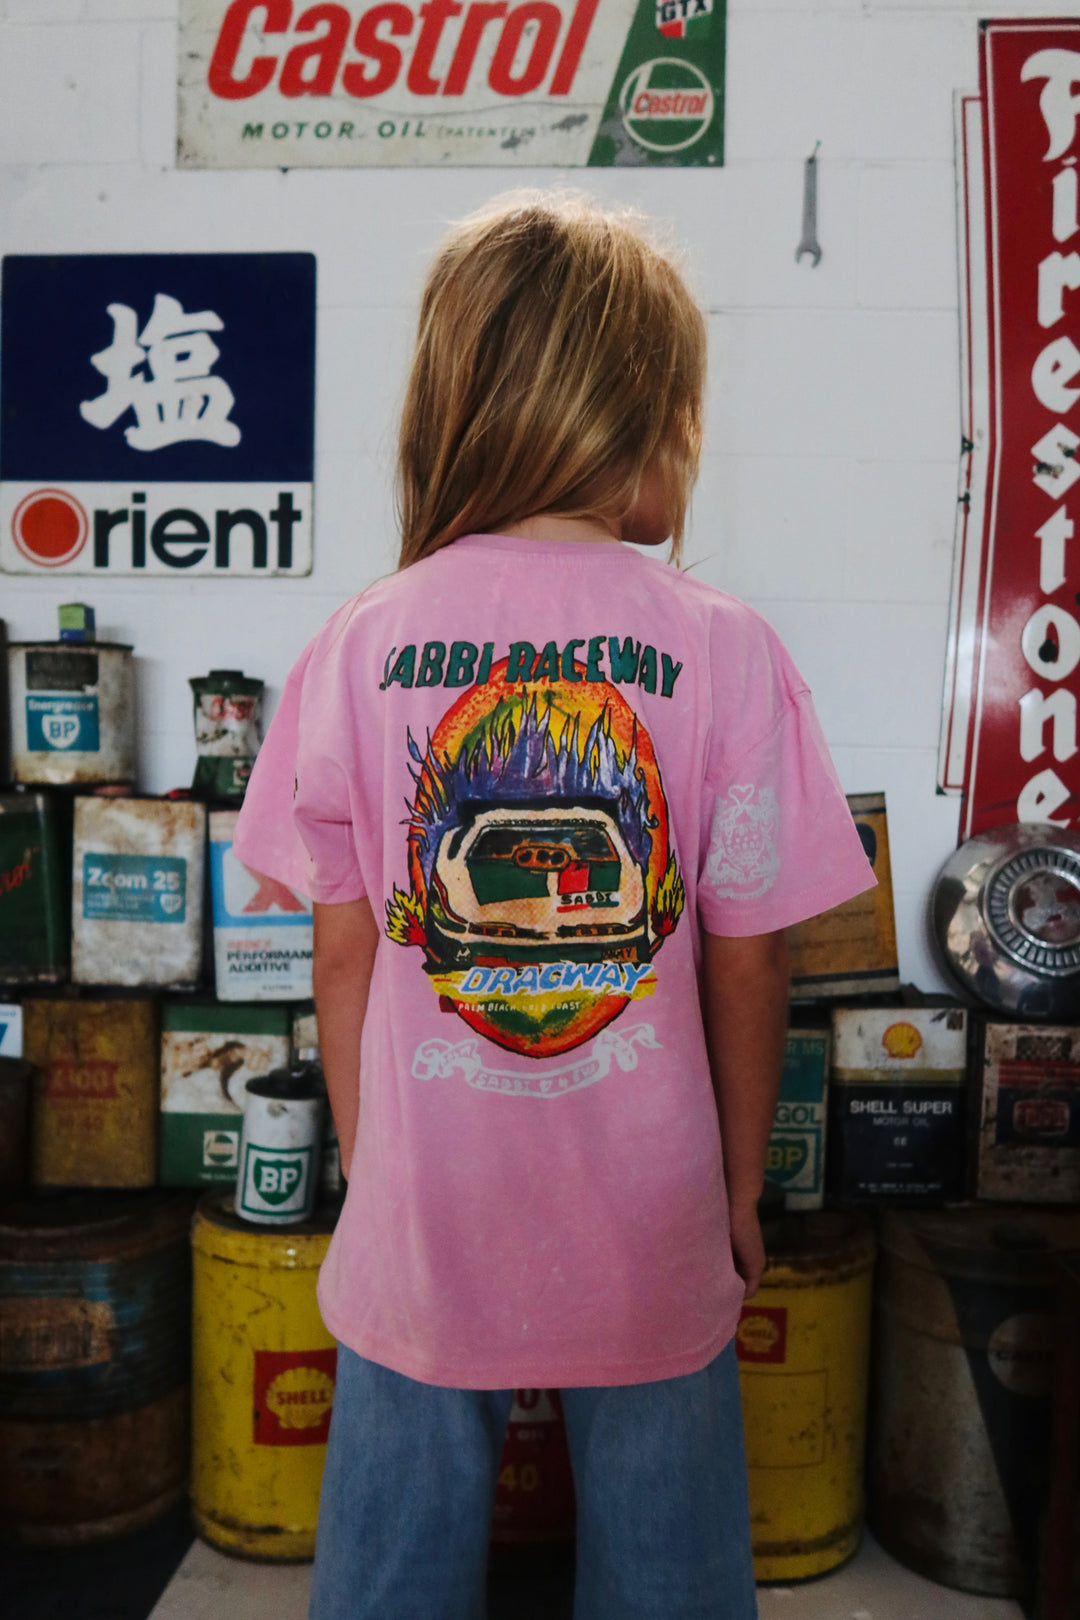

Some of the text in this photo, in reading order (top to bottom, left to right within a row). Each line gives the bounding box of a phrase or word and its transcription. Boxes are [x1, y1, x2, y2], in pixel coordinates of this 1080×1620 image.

[657, 0, 707, 22] GTX
[207, 0, 598, 99] Castrol
[634, 91, 708, 114] Castrol
[242, 121, 354, 139] MOTOR
[377, 121, 425, 138] OIL
[79, 293, 241, 451] 塩
[1020, 48, 1080, 828] Firestone
[505, 635, 683, 699] RACEWAY
[49, 720, 76, 739] BP
[87, 867, 180, 891] Zoom 25
[227, 950, 314, 961] PERFORMAN
[229, 962, 291, 973] ADDITIVE
[460, 961, 652, 995] DRAGWAY
[488, 1002, 516, 1012] BEACH
[850, 1100, 952, 1115] SHELL SUPER
[873, 1116, 909, 1127] MOTOR
[766, 1146, 802, 1171] BP
[259, 1166, 299, 1194] BP
[276, 1389, 327, 1406] SHELL
